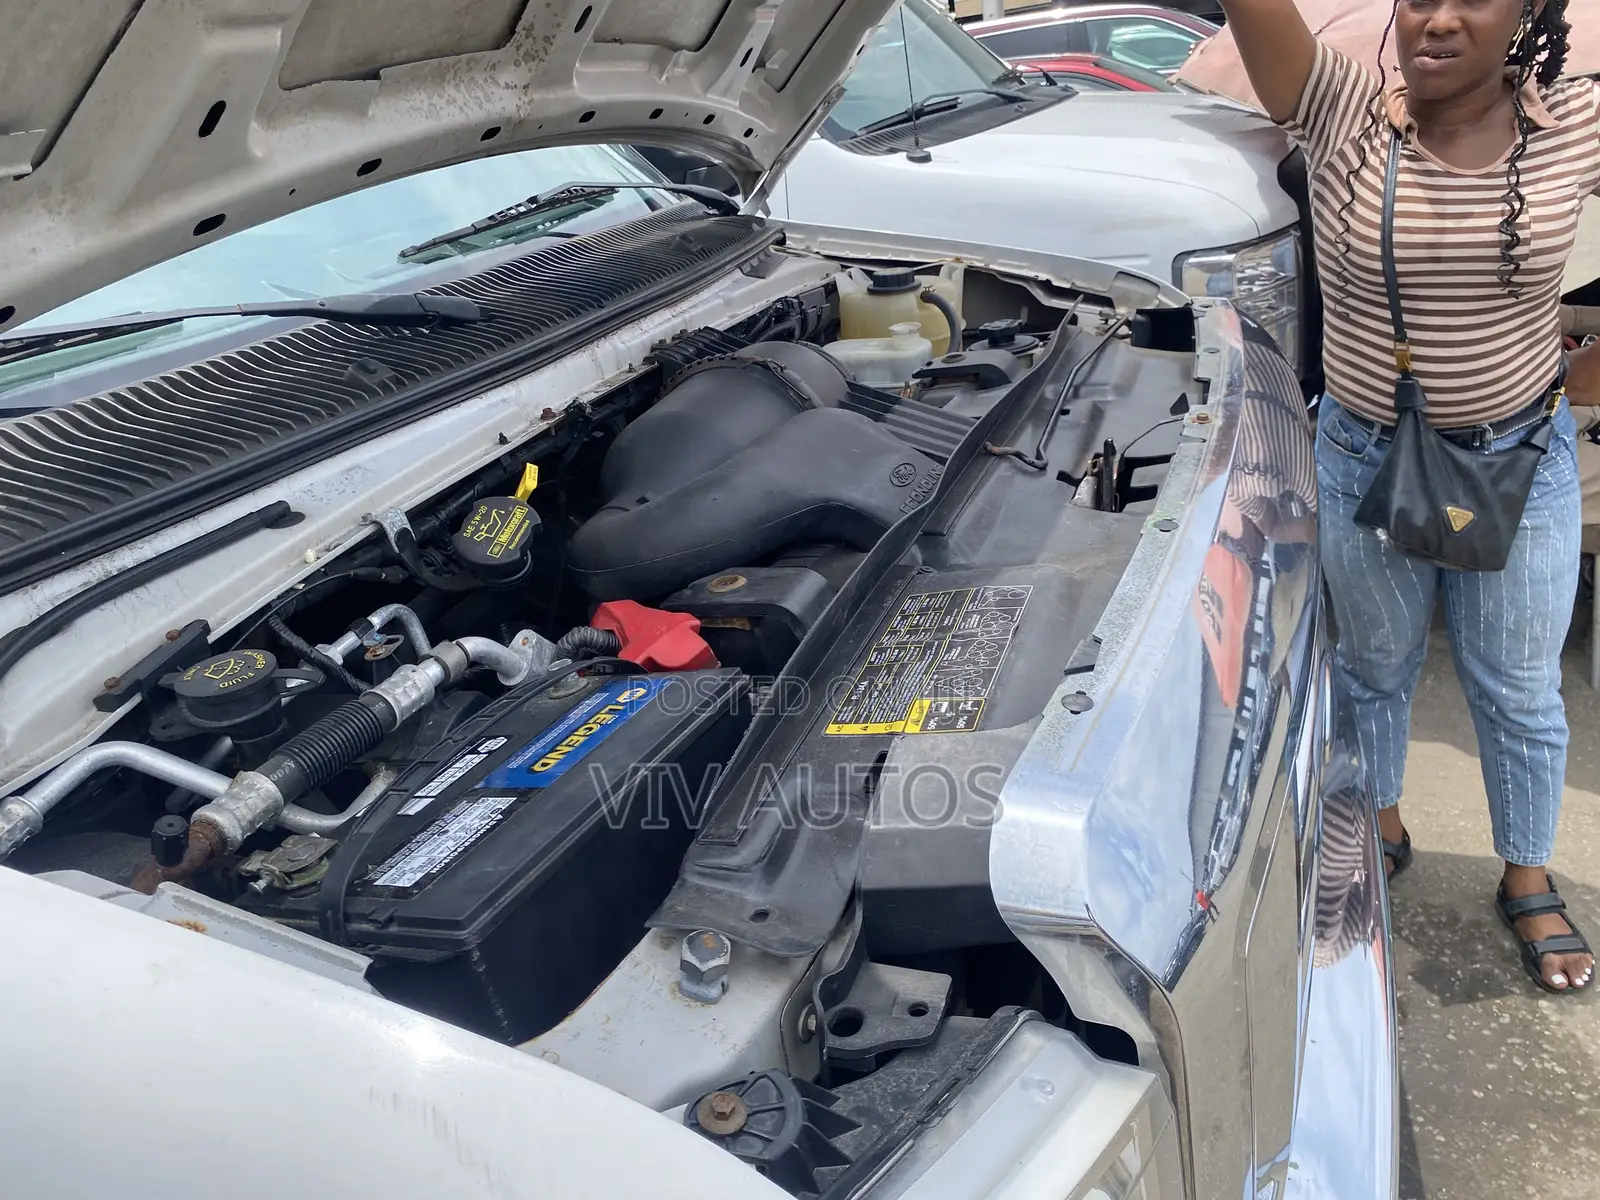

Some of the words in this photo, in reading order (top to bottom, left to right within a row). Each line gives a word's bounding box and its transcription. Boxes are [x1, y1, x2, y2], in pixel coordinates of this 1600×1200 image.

[463, 523, 476, 538] SAE
[219, 672, 255, 688] FLUID
[531, 704, 626, 772] LEGEND
